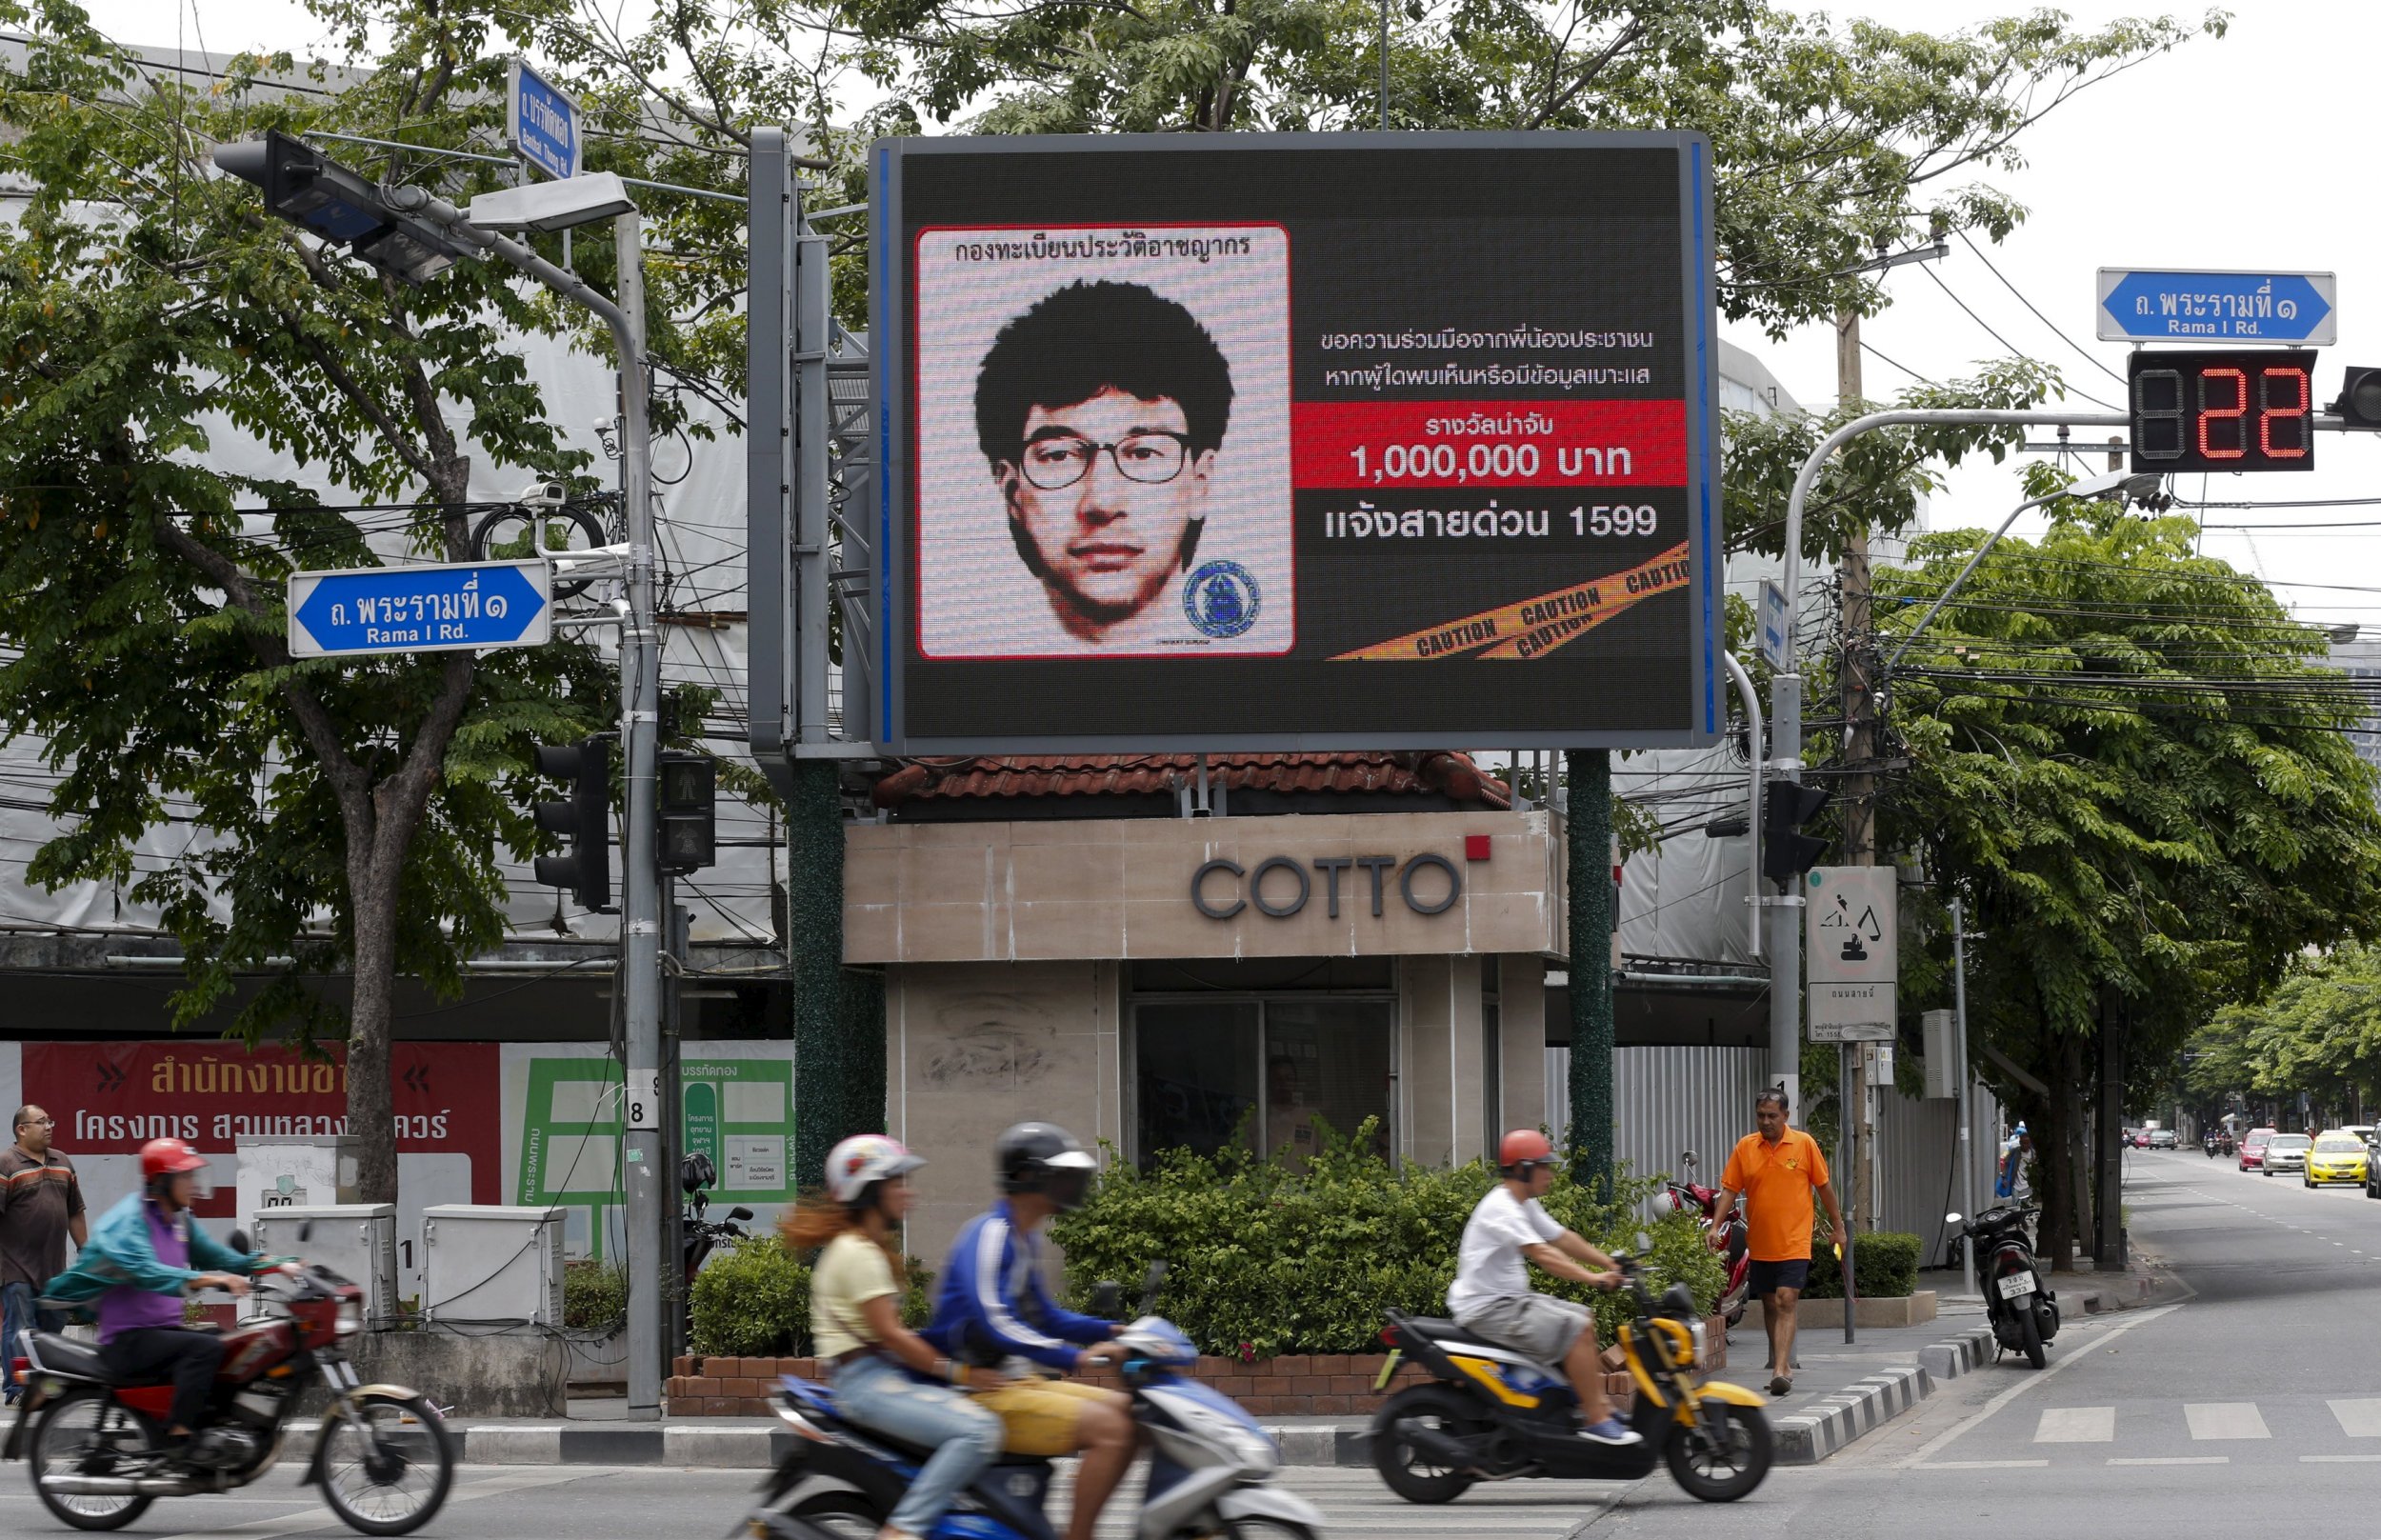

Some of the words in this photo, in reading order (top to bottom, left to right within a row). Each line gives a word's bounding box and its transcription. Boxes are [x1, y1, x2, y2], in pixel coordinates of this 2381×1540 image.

[522, 128, 542, 156] Banthat
[544, 143, 559, 172] Thong
[955, 230, 1251, 264] กองทะเบียนประวัติอาชญากร
[1321, 323, 1653, 350] ขอความร่วมมือจากพี่น้องประชาชน
[2169, 320, 2215, 334] Rama
[2235, 321, 2262, 335] Rd.
[1326, 362, 1651, 391] หากผู้ใดพบเห็นหรือมีข้อมูลเบาะแส
[1425, 411, 1553, 435] รางวัลนำจับ
[1350, 444, 1539, 484] 1,000,000
[1557, 446, 1631, 476] บาท
[1325, 499, 1550, 537] แจ้งสายด่วน
[1570, 505, 1657, 536] 1599
[368, 628, 419, 644] Rama
[440, 624, 469, 639] Rd.
[1416, 619, 1496, 658] CAUTION
[1521, 588, 1601, 626] CAUTION
[1191, 853, 1461, 919] COTTO
[1831, 986, 1874, 998] ถนนสายนี้
[151, 1055, 349, 1093] สำนักงานขา
[75, 1110, 199, 1140] โครงการ
[631, 1102, 644, 1123] 8
